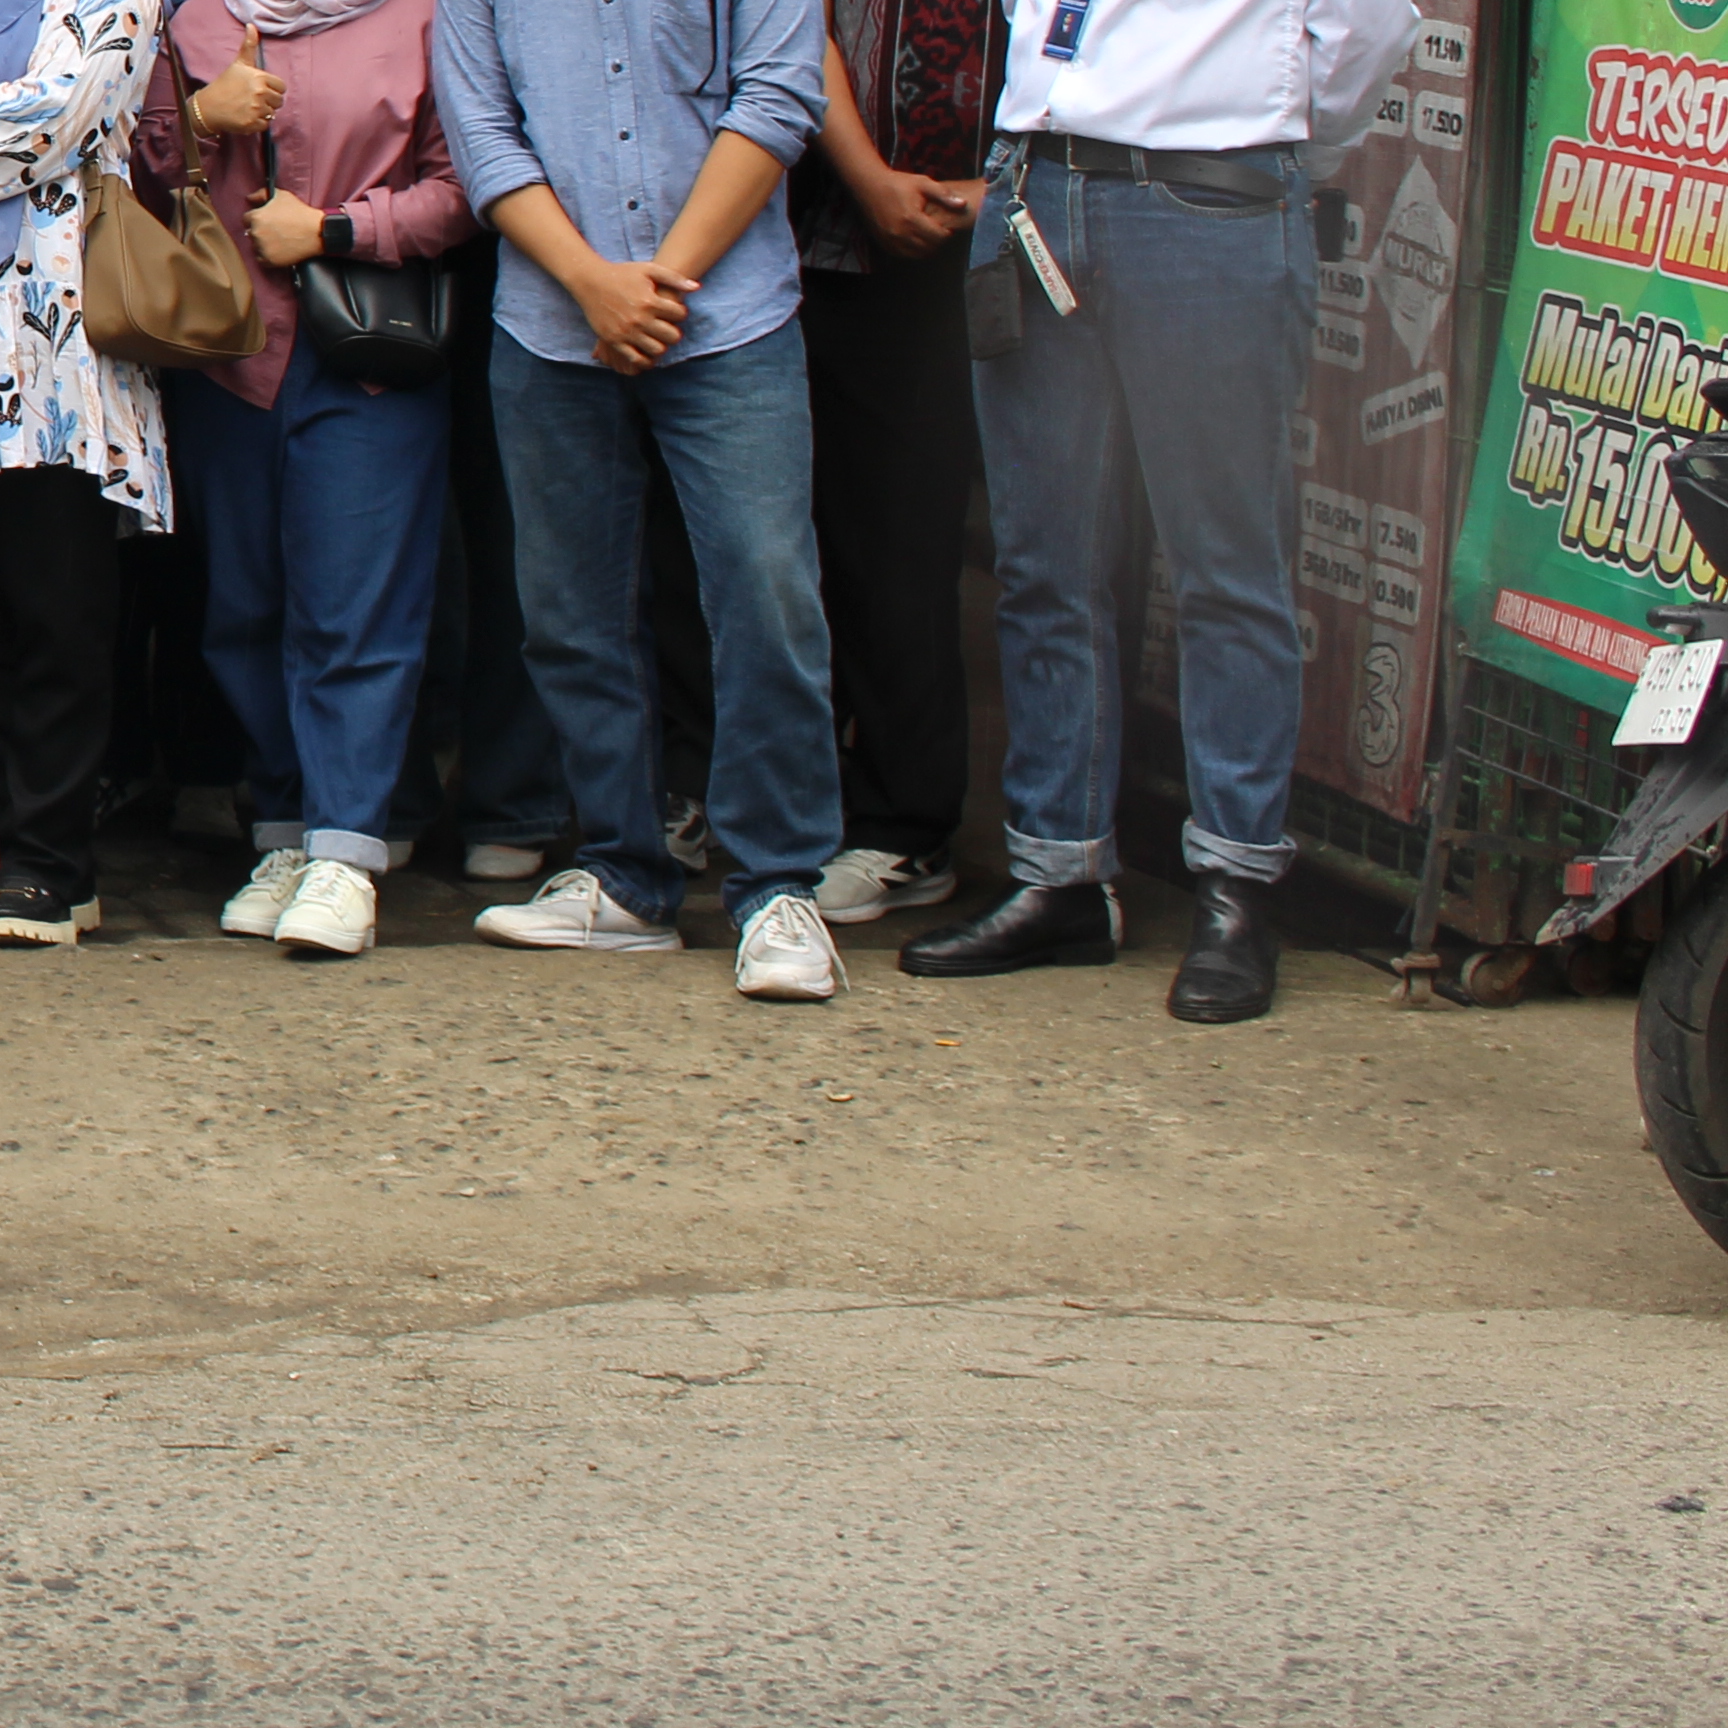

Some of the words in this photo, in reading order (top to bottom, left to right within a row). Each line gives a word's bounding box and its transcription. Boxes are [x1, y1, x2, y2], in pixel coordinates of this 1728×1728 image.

[1595, 60, 1728, 156] TERSED
[1543, 152, 1675, 257] PAKET
[1526, 303, 1651, 413] Mulai
[1514, 403, 1567, 496] Rp.
